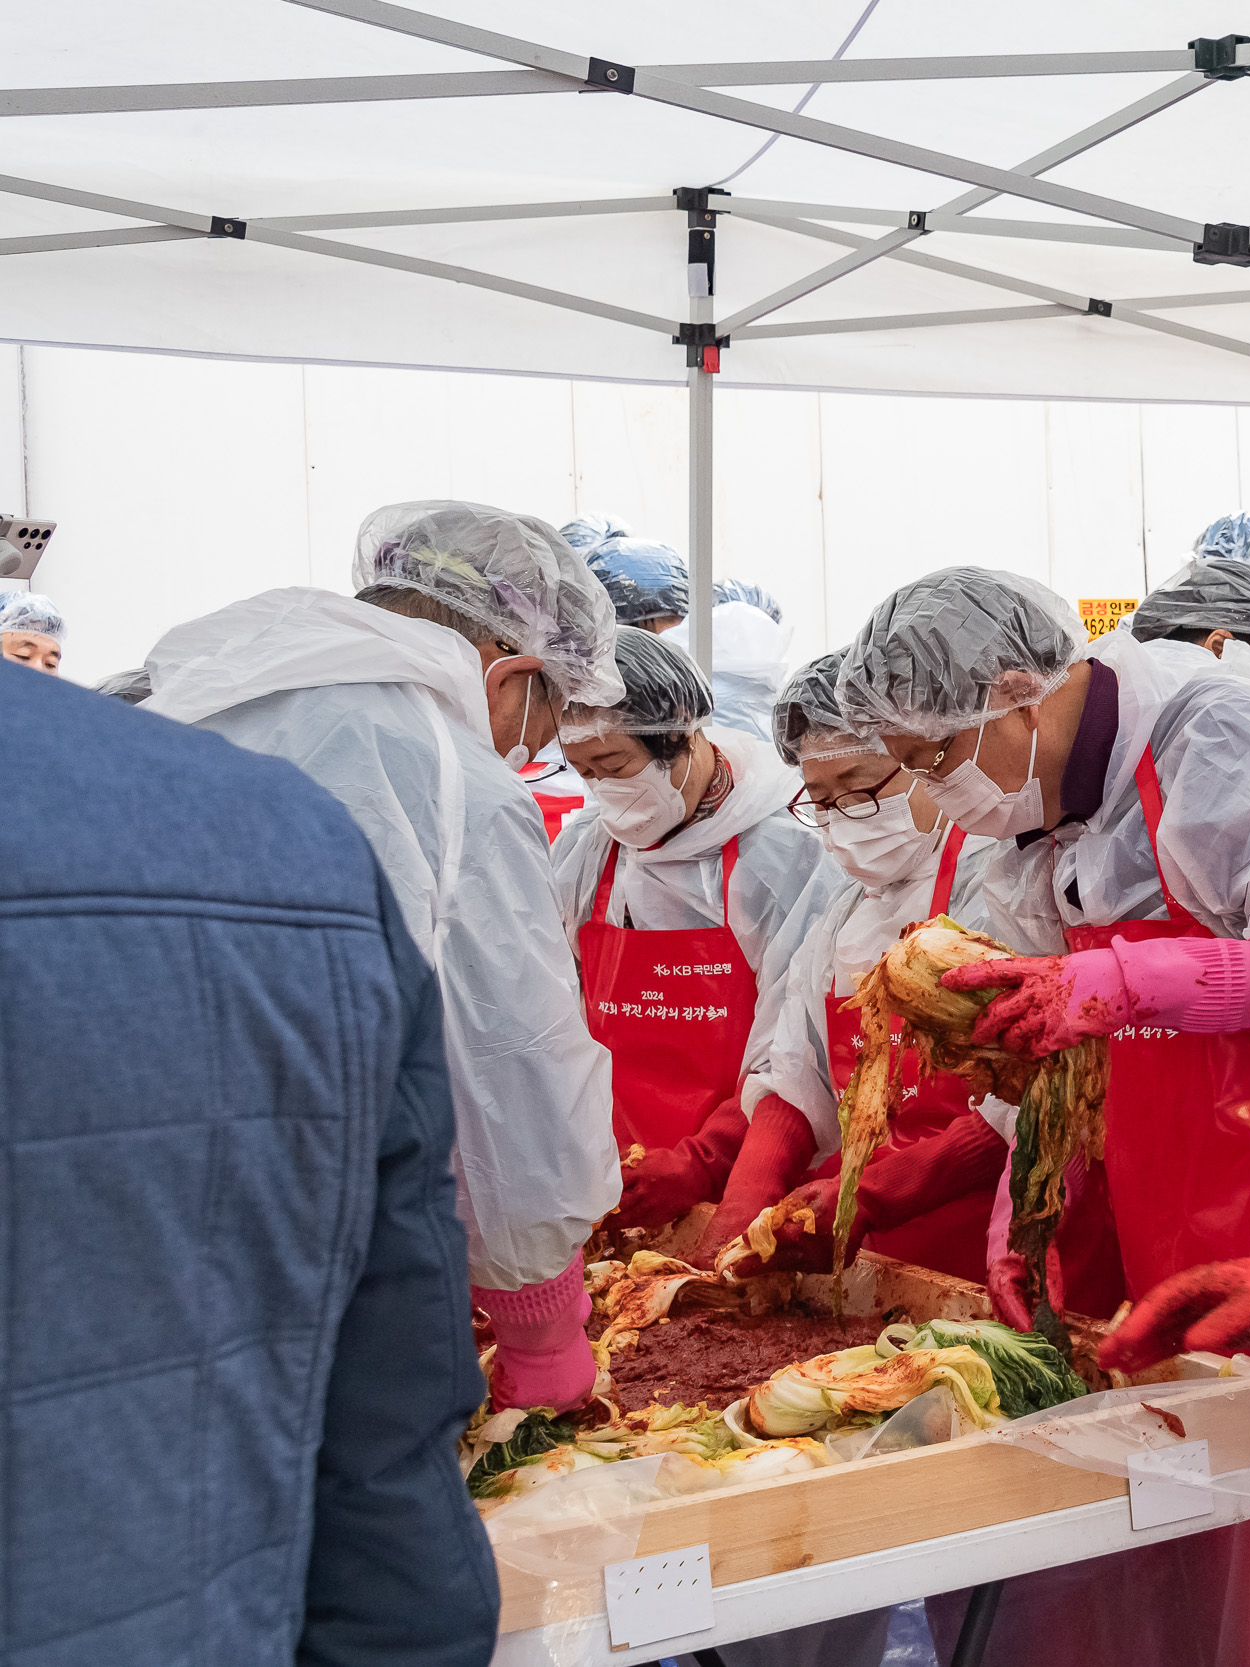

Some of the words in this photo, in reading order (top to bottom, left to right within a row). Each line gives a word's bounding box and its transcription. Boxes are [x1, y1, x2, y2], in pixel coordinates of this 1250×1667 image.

[1082, 602, 1135, 616] 금성인력
[641, 990, 664, 1001] 2024
[620, 1002, 643, 1018] 광진
[645, 1005, 679, 1020] 사랑의
